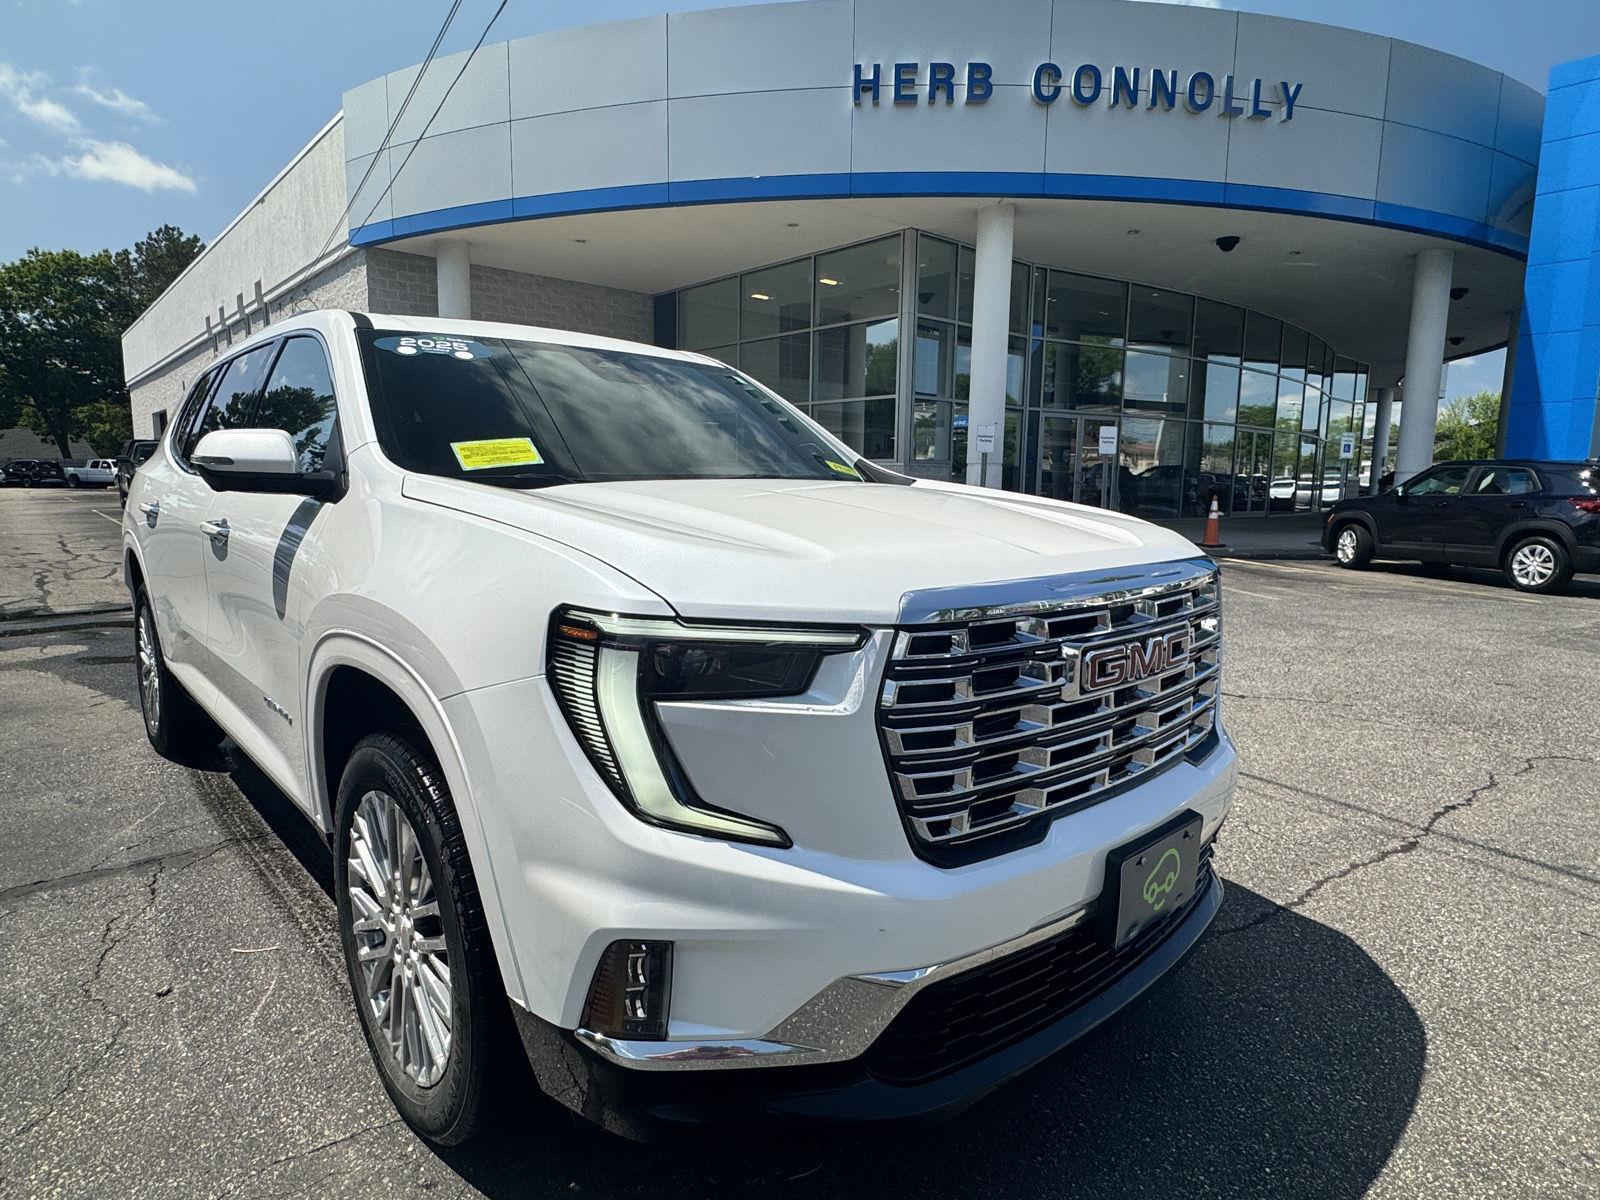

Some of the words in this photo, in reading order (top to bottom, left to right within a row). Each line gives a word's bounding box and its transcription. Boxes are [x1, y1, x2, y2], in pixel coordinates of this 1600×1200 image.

[853, 62, 994, 107] HERB
[1031, 62, 1303, 123] CONNOLLY
[400, 337, 469, 351] 2025
[1084, 628, 1191, 691] GMC
